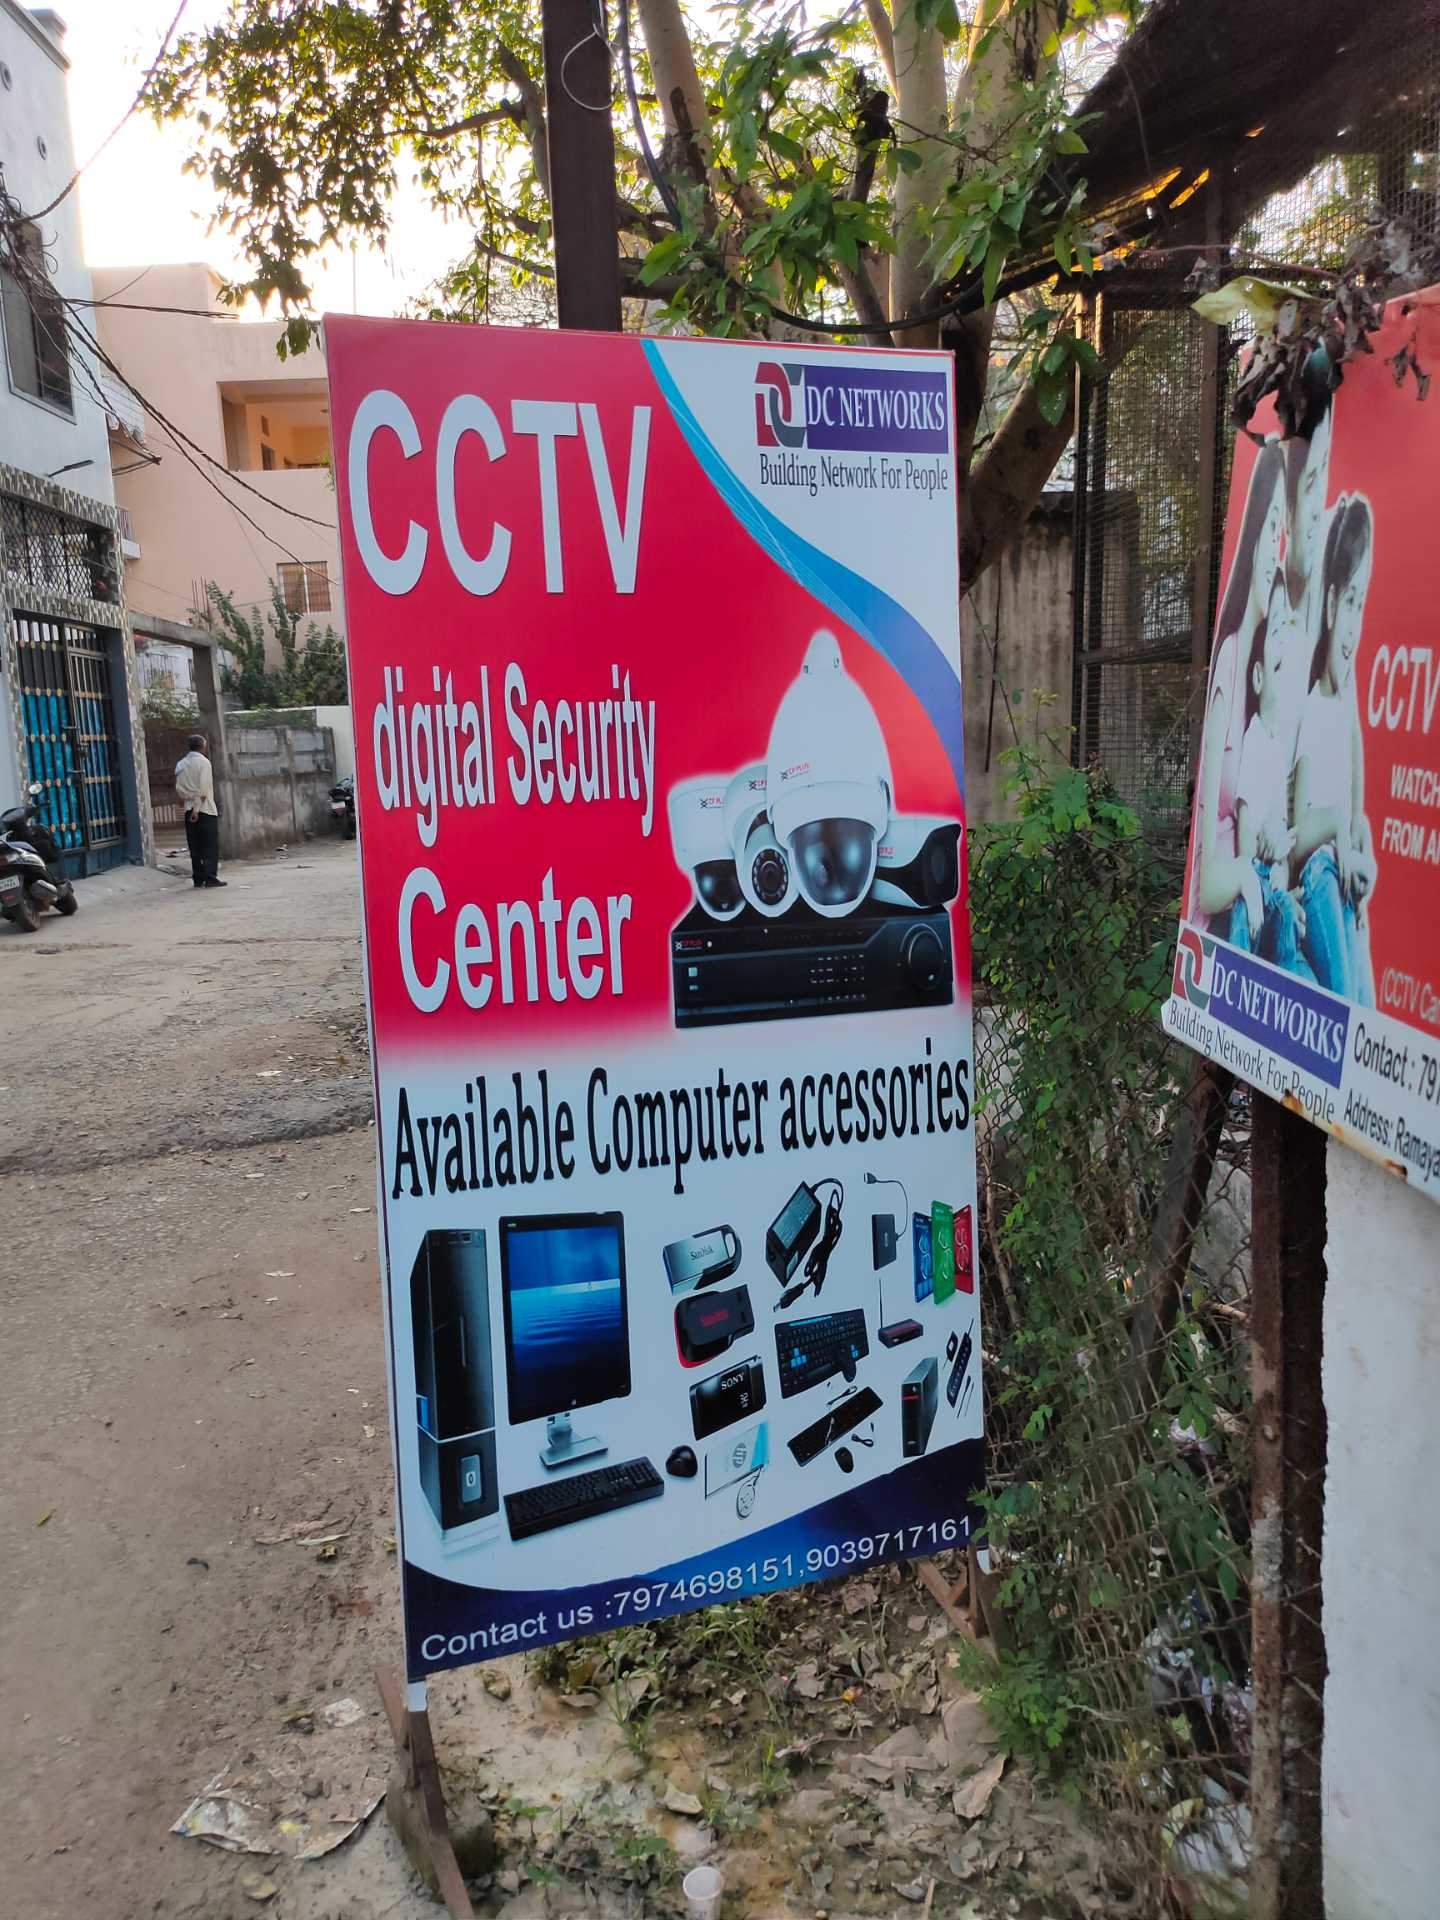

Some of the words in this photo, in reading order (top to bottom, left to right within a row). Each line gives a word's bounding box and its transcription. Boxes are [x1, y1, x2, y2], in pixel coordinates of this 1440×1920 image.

[807, 386, 834, 426] DC
[839, 387, 945, 431] NETWORKS
[348, 389, 652, 596] CCTV
[760, 453, 818, 497] Building
[821, 456, 878, 488] Network
[881, 458, 902, 489] For
[905, 459, 948, 500] People
[1368, 644, 1440, 735] CCTV
[372, 665, 496, 849] digital
[504, 661, 656, 838] Security
[1391, 764, 1440, 808] WATCH
[1381, 816, 1425, 861] FROM
[1424, 829, 1440, 865] A
[398, 867, 632, 1012] Center
[1211, 961, 1238, 1007] DC
[1238, 975, 1344, 1064] NETWORKS
[1169, 1000, 1213, 1058] Building
[1215, 1026, 1263, 1080] Network
[1266, 1054, 1289, 1092] For
[1291, 1071, 1335, 1125] People
[1353, 1022, 1408, 1087] Contact
[392, 1069, 576, 1199] Available
[586, 1067, 768, 1194] Computer
[780, 1038, 970, 1152] accessories
[1344, 1088, 1394, 1148] Address:
[721, 1372, 744, 1390] SONY
[421, 1618, 547, 1662] Contact
[558, 1603, 594, 1631] us
